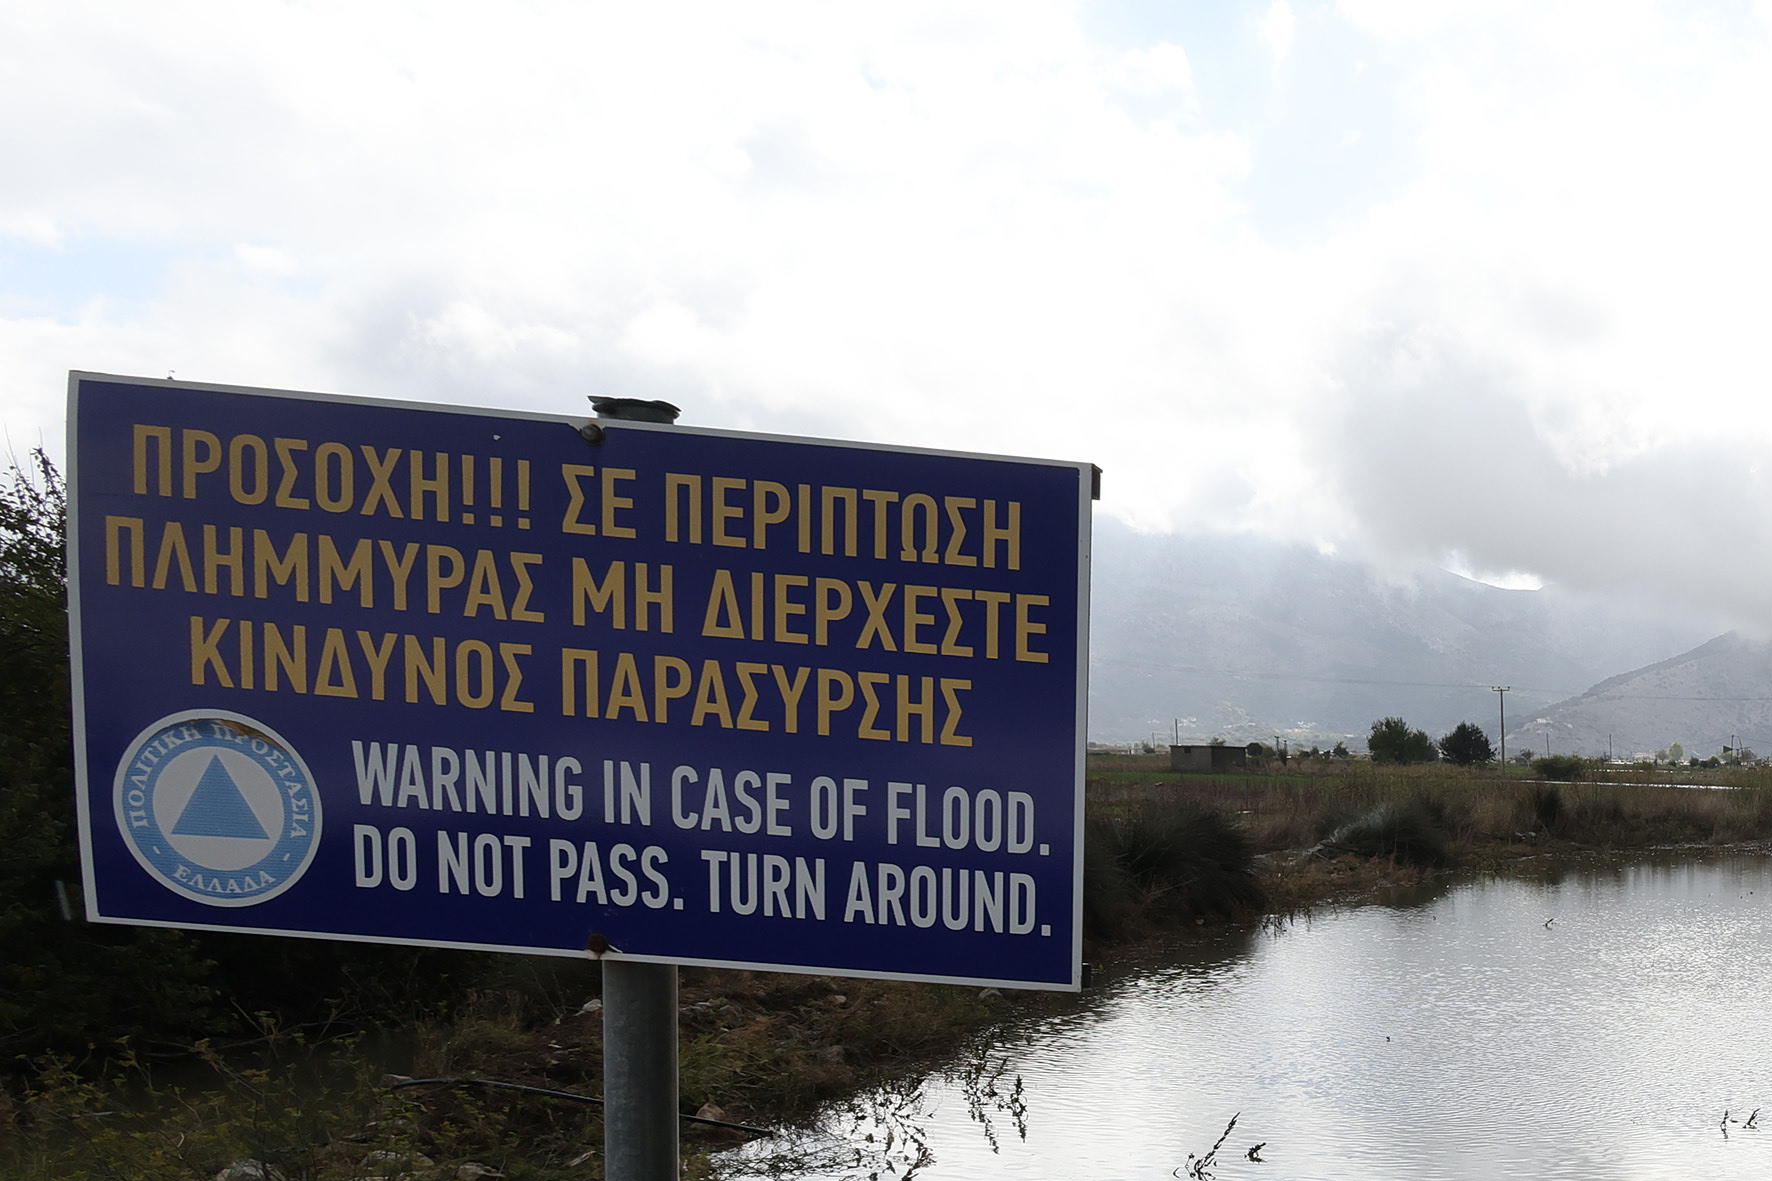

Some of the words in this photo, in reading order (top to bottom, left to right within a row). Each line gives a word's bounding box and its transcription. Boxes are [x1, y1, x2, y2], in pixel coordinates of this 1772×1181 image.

[133, 423, 530, 529] ΠΡΟΣΟΧΗ!!!
[561, 463, 637, 539] ΣΕ
[665, 472, 1021, 571] ΠΕΡΙΠΤΩΣΗ
[105, 515, 545, 623] ΠΛΗΜΜΥΡΑΣ
[572, 557, 674, 634] ΜΗ
[701, 569, 1050, 664] ΔΙΕΡΧΕΣΤΕ
[190, 615, 535, 713] ΚΙΝΔΥΝΟΣ
[561, 647, 973, 747] ΠΑΡΑΣΥΡΣΗΣ
[128, 724, 203, 829] ΠΟΛΙΤΙΚΗ
[351, 740, 583, 821] WARNING
[603, 759, 651, 826] IN
[671, 765, 792, 838] CASE
[810, 775, 869, 842] OF
[887, 781, 1050, 856] FLOOD.
[172, 863, 277, 894] ΕΛΛΑΔΑ
[353, 823, 417, 891] DO
[437, 830, 532, 899] NOT
[549, 838, 684, 910] PASS.
[700, 849, 826, 921] TURN
[843, 861, 1051, 937] AROUND.
